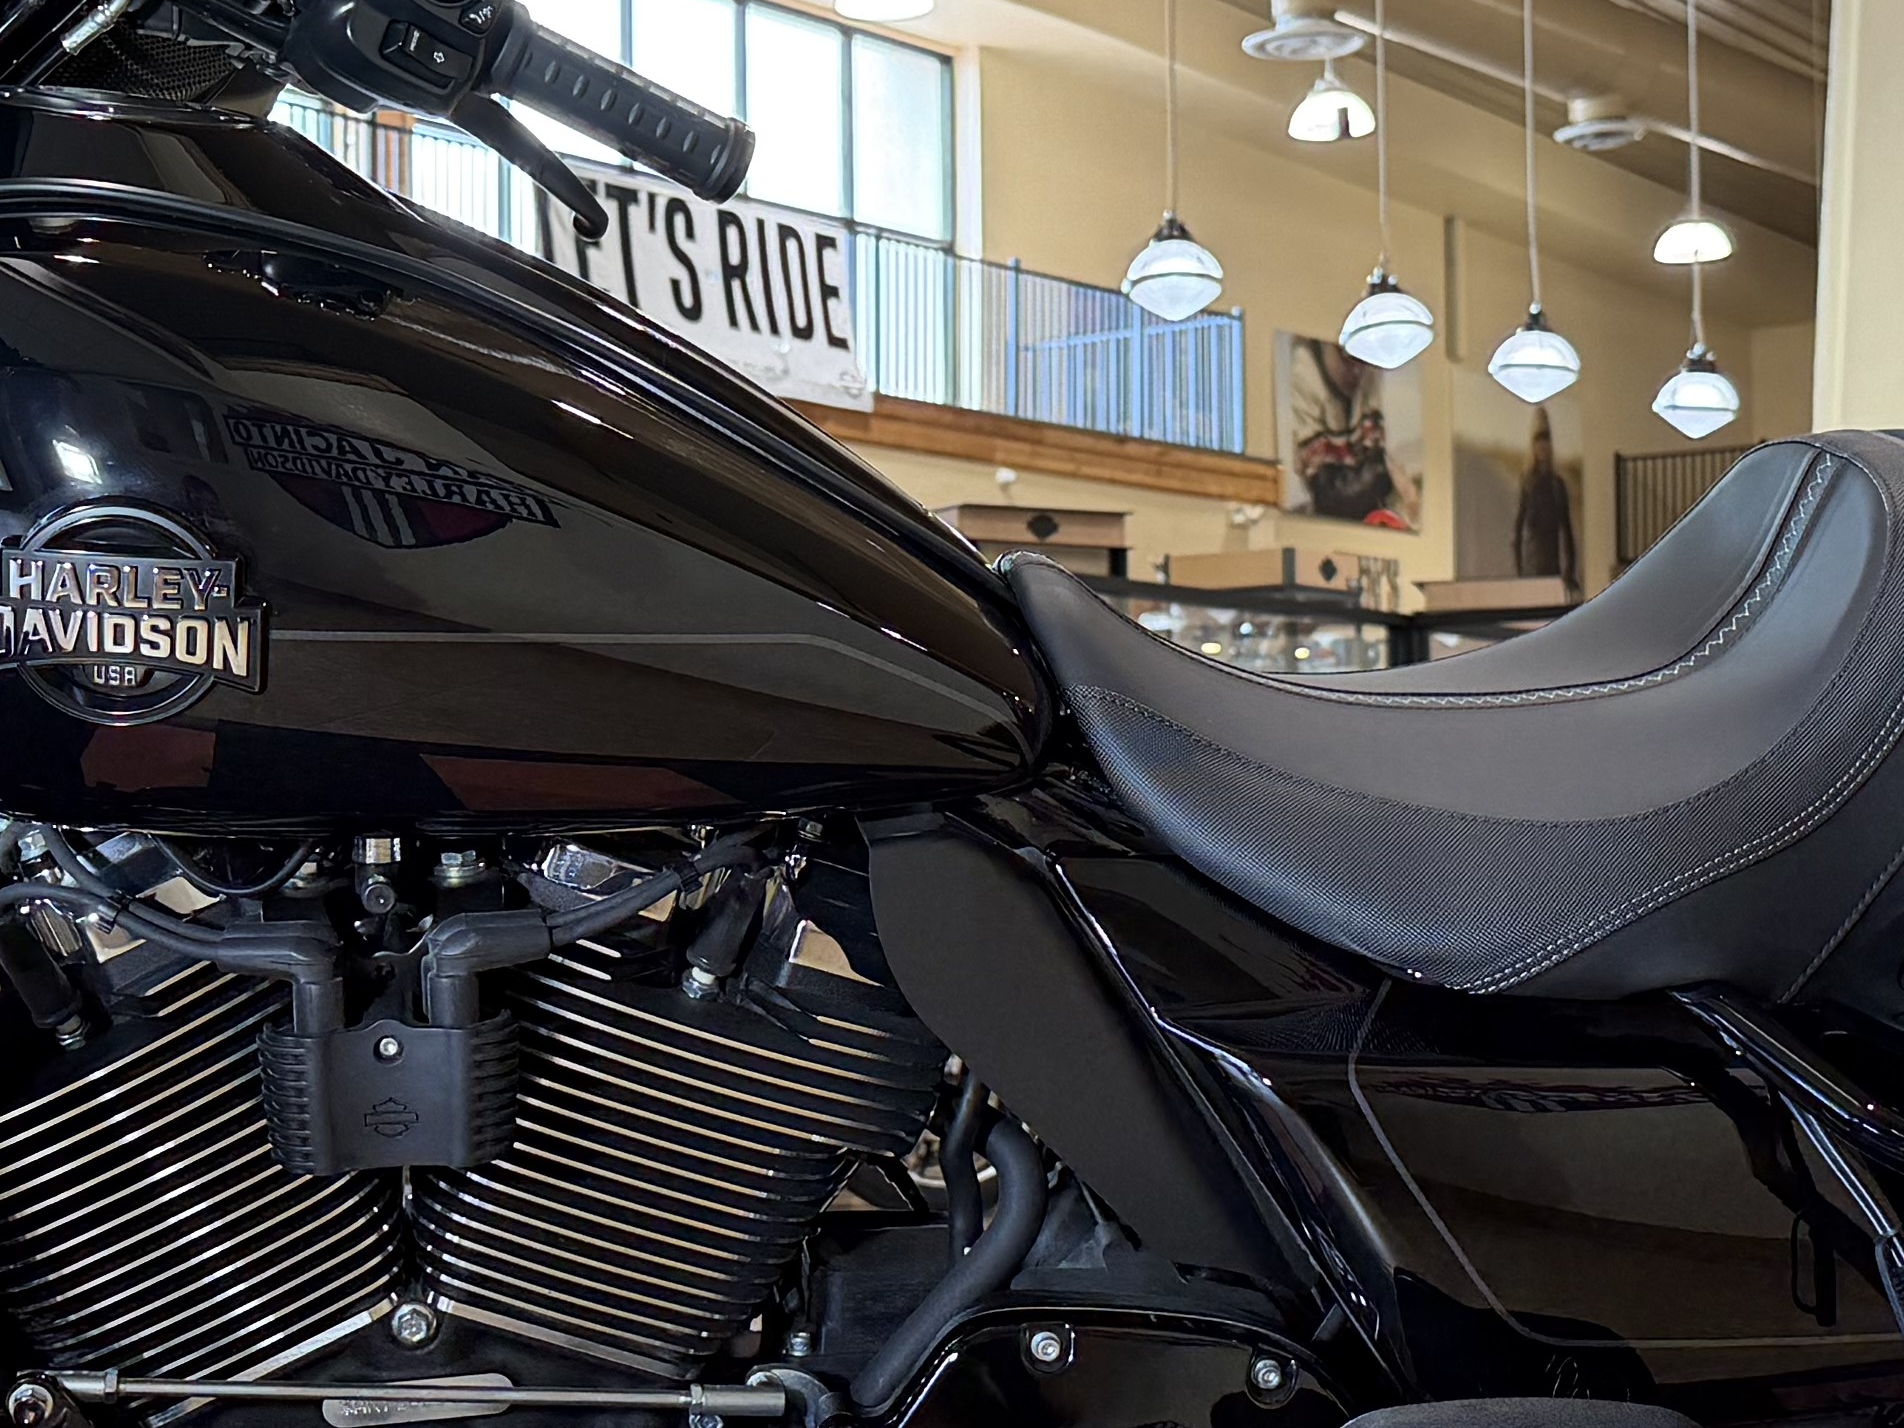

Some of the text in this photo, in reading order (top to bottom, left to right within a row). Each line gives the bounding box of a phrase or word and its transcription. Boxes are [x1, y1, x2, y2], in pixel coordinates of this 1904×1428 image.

[716, 208, 851, 352] RIDE
[8, 558, 228, 611] HARLEY-
[94, 665, 136, 687] USA
